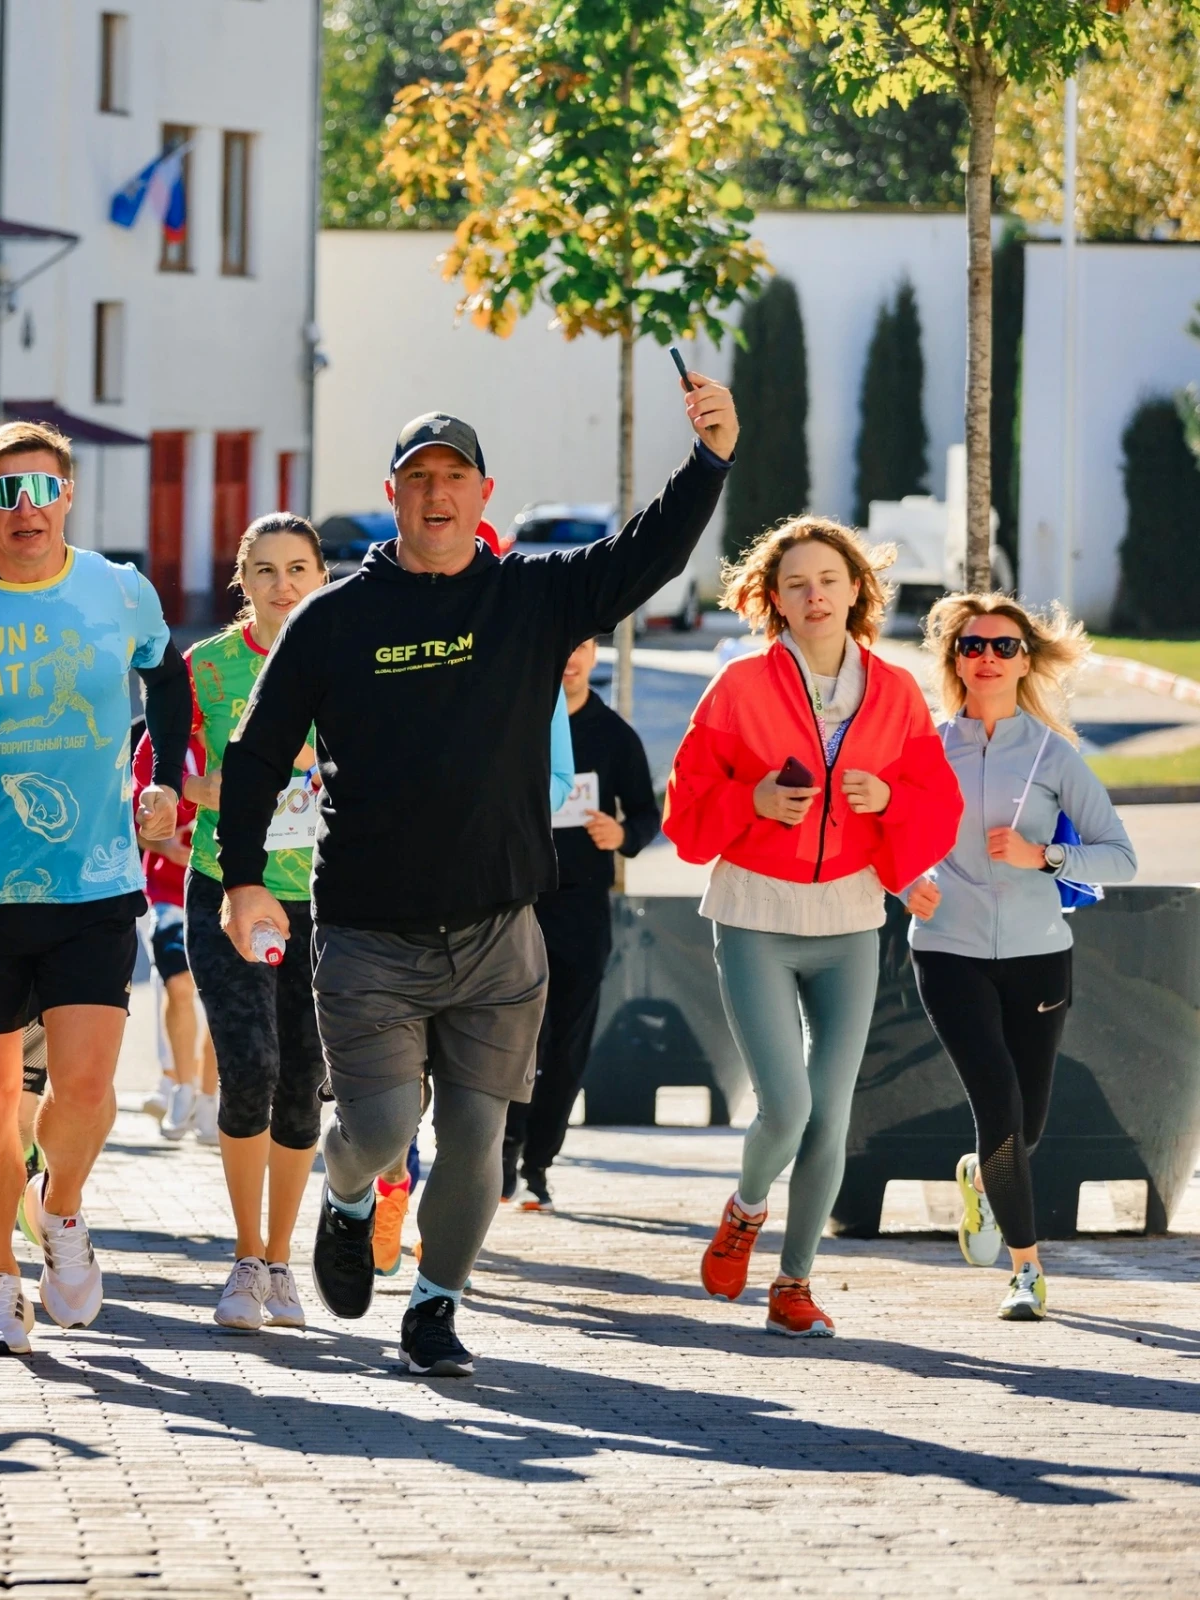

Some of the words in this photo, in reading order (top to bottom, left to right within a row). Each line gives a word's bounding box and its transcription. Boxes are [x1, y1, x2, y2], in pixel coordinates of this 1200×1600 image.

[34, 623, 49, 644] &
[375, 645, 418, 663] GEF
[421, 632, 473, 657] TEAM
[63, 735, 89, 750] ЗАБЕГ
